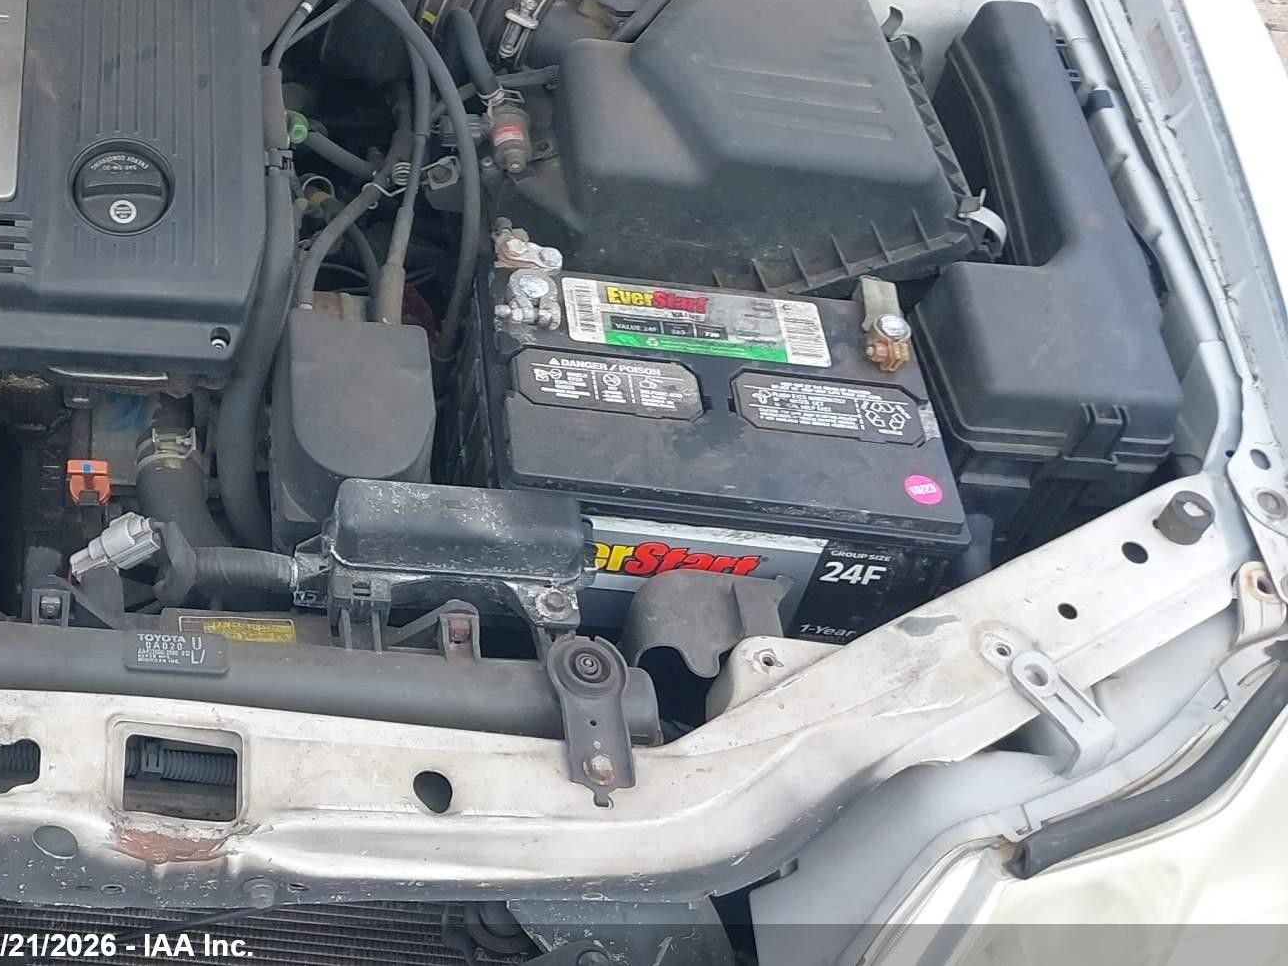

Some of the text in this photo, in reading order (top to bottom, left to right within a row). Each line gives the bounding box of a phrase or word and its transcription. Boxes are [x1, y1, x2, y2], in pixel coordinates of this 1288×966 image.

[606, 286, 708, 314] EverStart
[560, 358, 608, 371] DANGER
[619, 365, 662, 376] POISON
[593, 541, 762, 577] erStart
[830, 550, 893, 562] GROUP SIZE
[819, 561, 887, 586] 24F
[137, 633, 186, 643] TOYOTA
[800, 623, 857, 637] 1-Year
[191, 636, 202, 650] U
